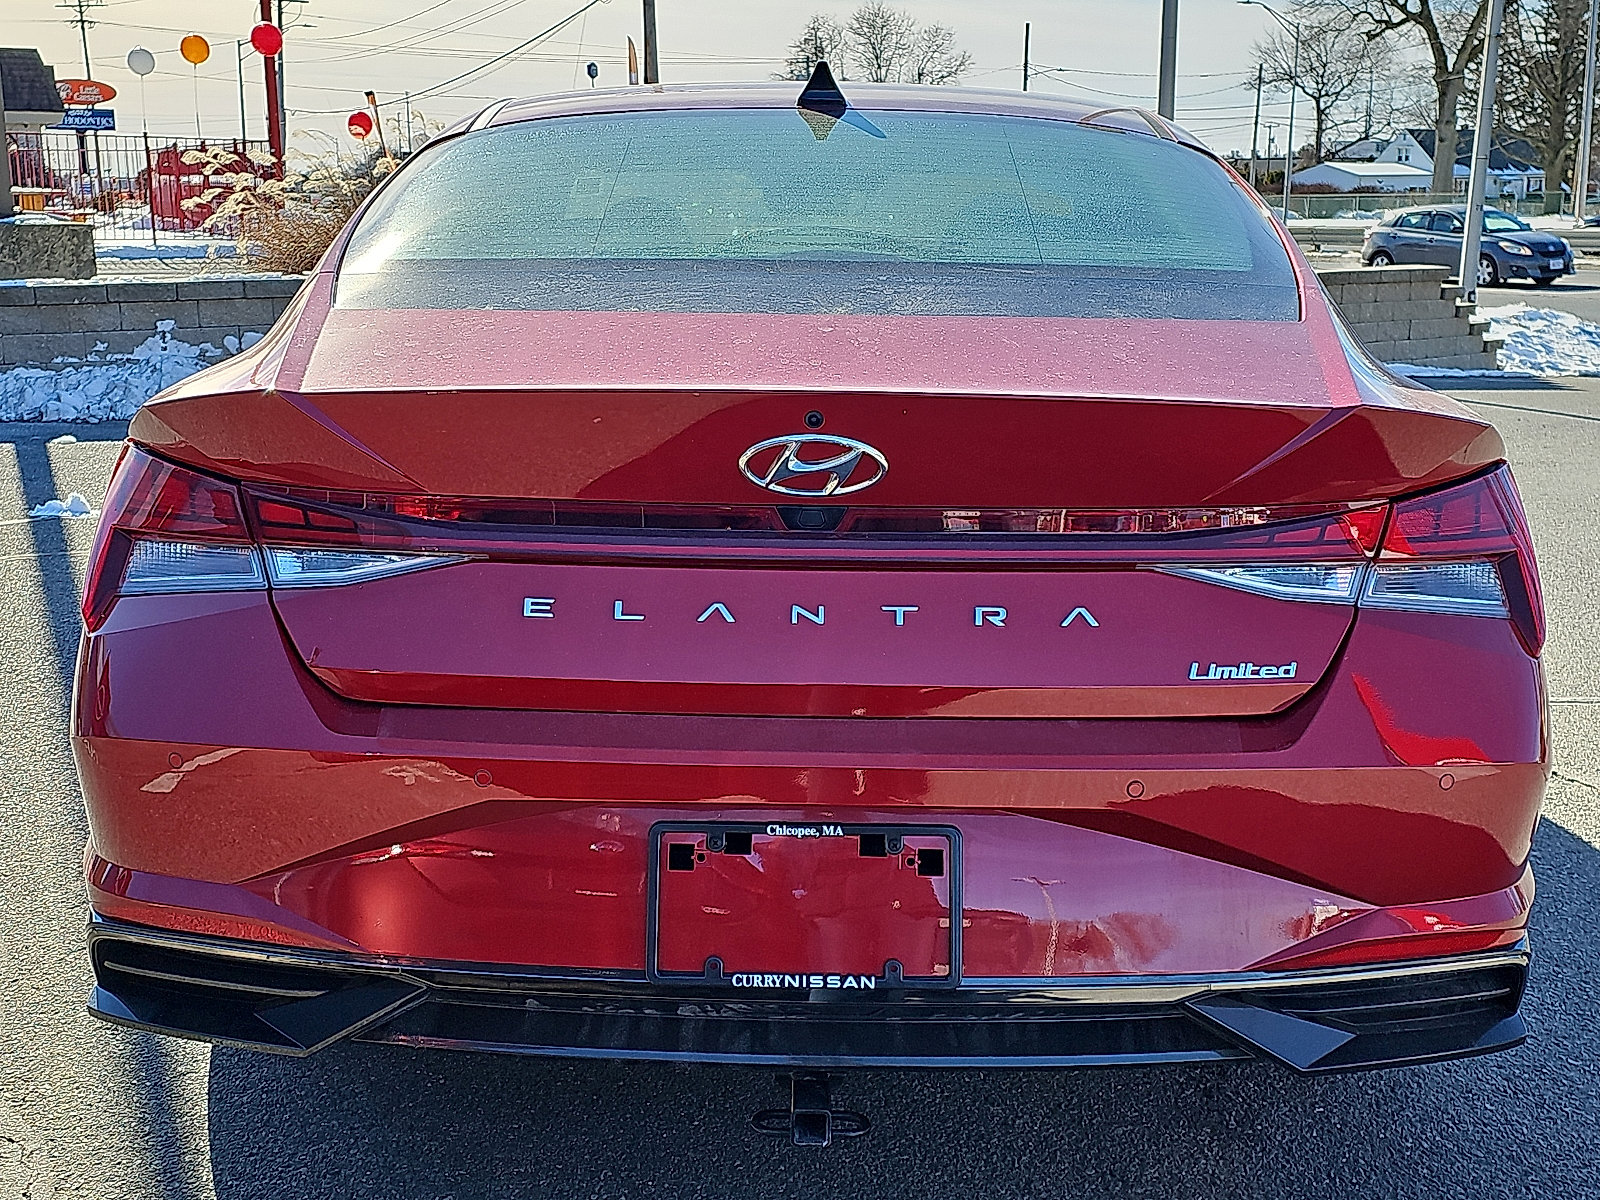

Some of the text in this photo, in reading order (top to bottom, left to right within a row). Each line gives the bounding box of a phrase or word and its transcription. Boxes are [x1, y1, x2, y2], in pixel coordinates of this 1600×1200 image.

[522, 597, 1100, 627] ELANTRA
[1189, 662, 1297, 680] Limited
[766, 824, 844, 838] Chicopee, MA
